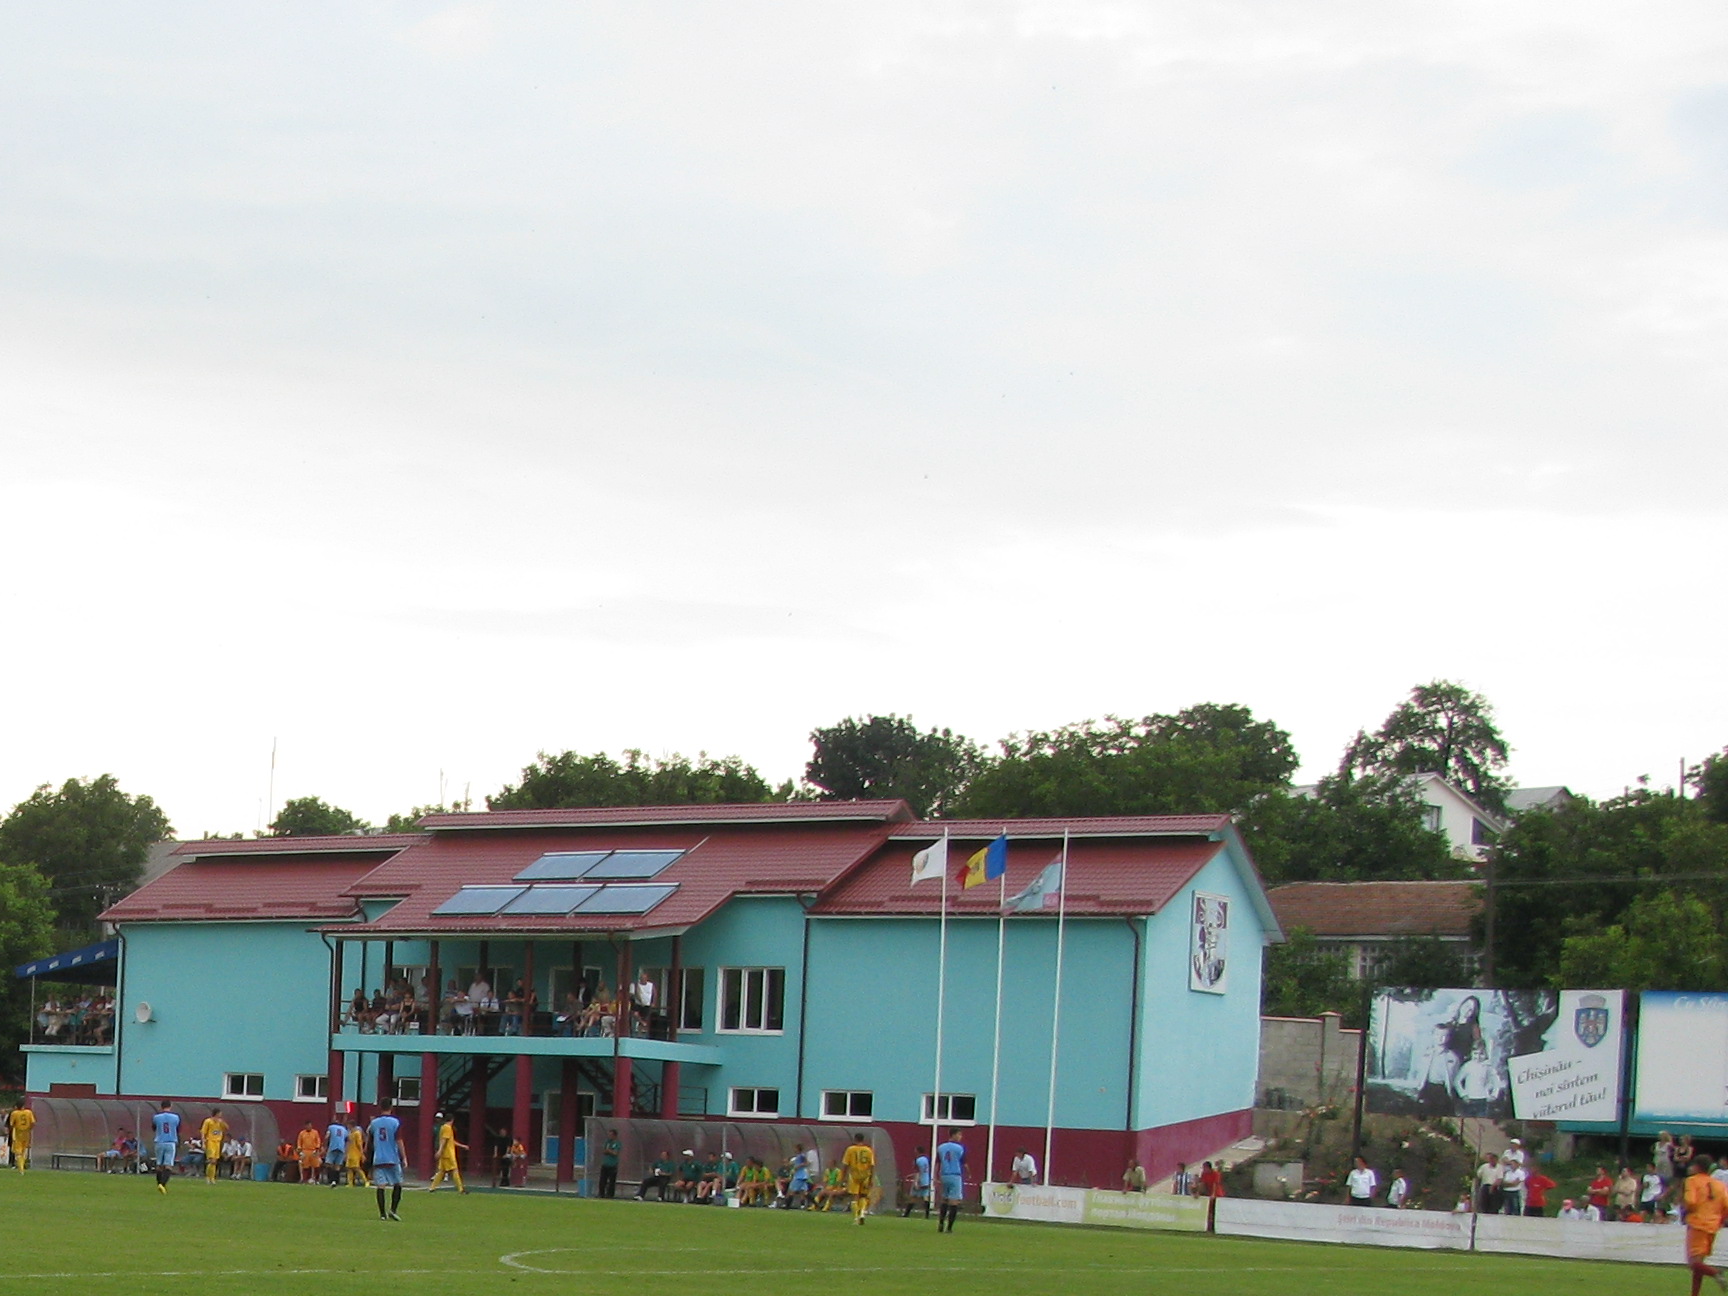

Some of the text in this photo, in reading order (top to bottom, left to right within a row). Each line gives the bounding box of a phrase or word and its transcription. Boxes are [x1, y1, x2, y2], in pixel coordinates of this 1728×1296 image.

[378, 1127, 387, 1142] 5
[854, 1150, 868, 1164] 16
[943, 1150, 952, 1163] 4
